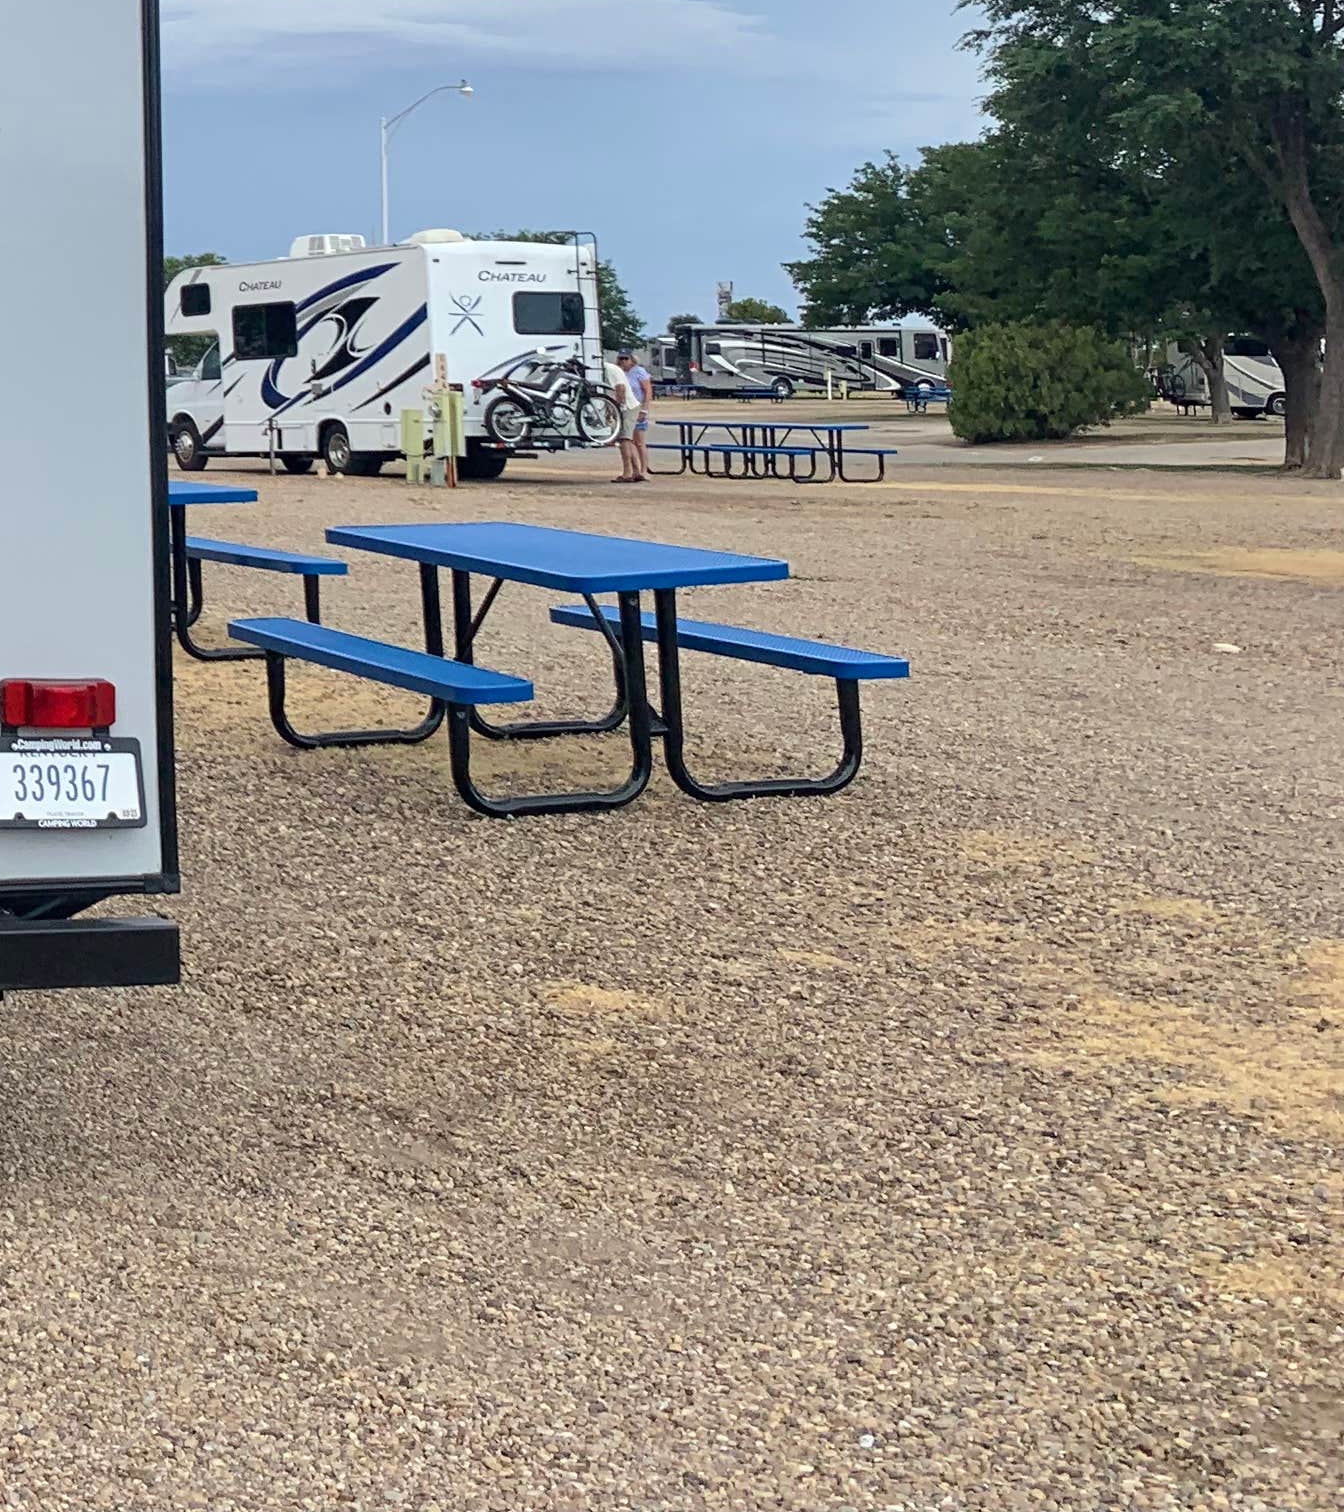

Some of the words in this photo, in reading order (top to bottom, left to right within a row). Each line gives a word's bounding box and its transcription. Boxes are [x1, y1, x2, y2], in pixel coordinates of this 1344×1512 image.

[477, 270, 547, 283] CHATEAU
[238, 280, 282, 292] CHATEAU
[17, 738, 102, 752] CampingWorld.com
[13, 764, 110, 801] 339367
[38, 819, 70, 828] CAMPING
[71, 819, 97, 828] WORLD
